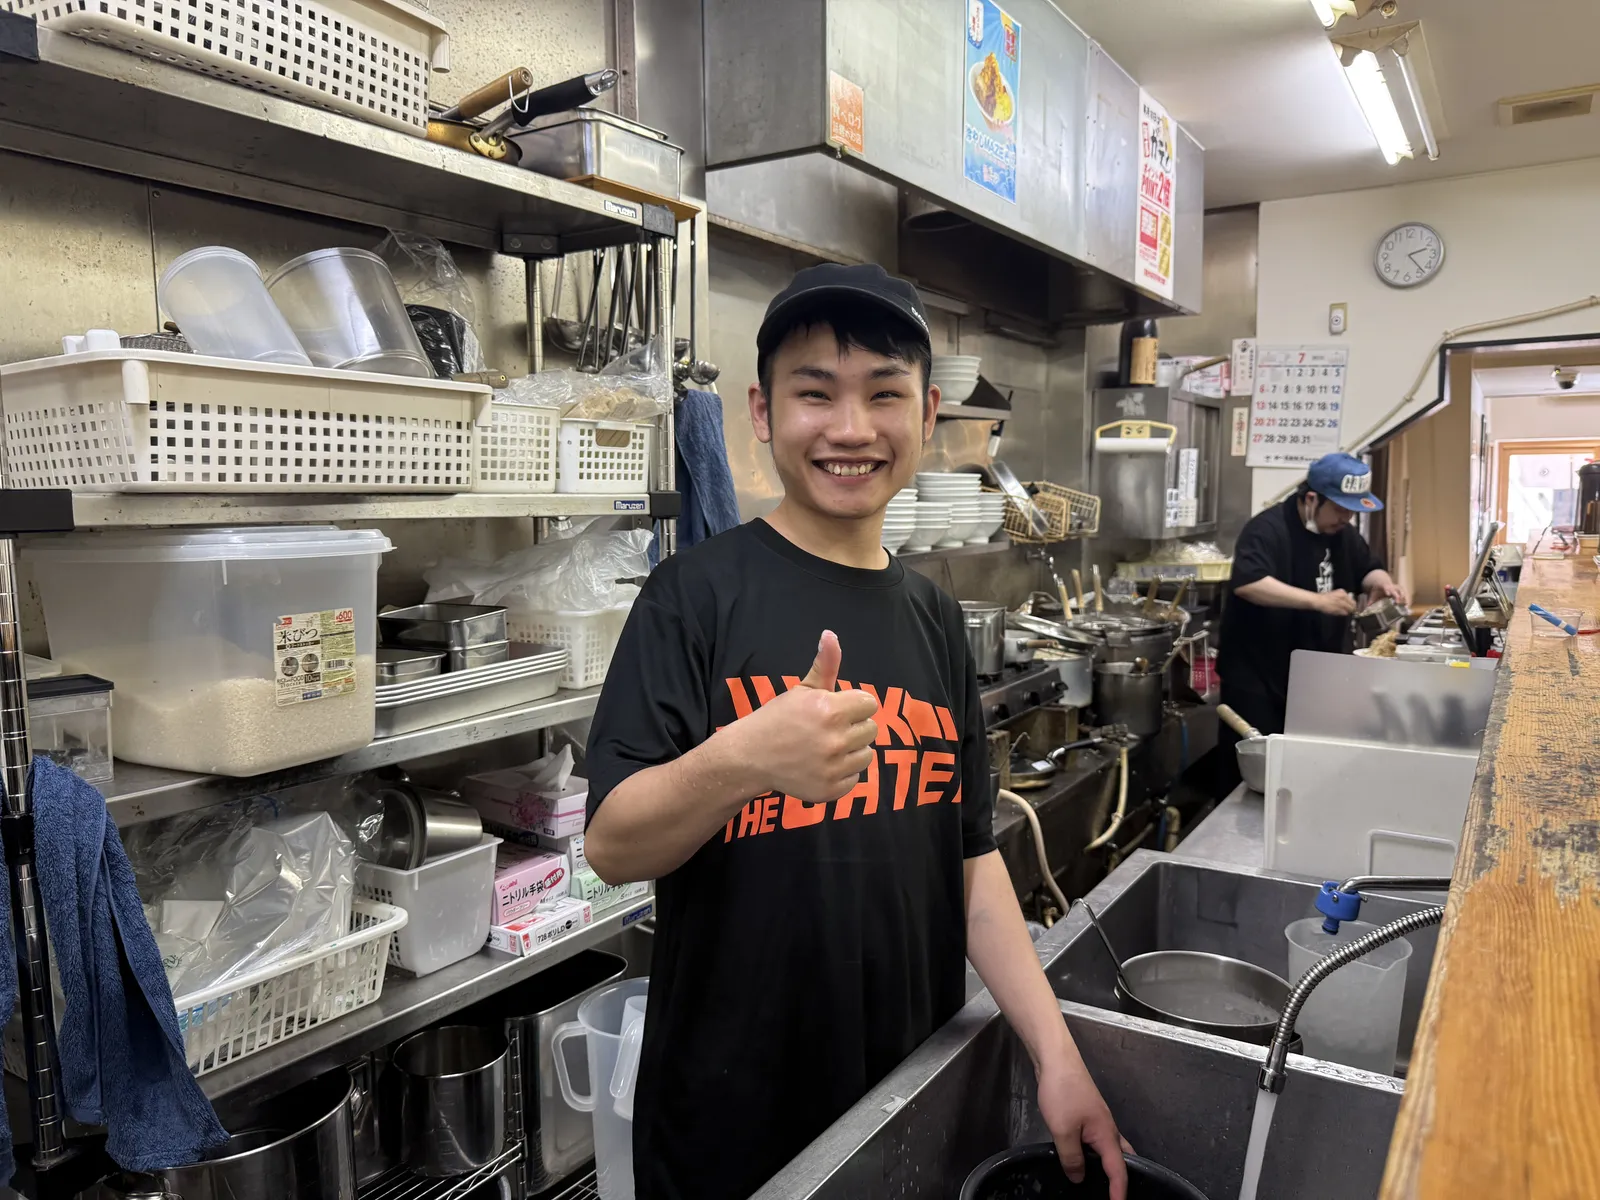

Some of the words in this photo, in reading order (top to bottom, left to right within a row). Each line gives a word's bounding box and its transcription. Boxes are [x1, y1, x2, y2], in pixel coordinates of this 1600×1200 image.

[1395, 232, 1401, 242] 11
[1406, 228, 1415, 239] 12
[1385, 241, 1394, 251] 10
[1425, 236, 1432, 246] 2
[1381, 252, 1388, 262] 9
[1429, 249, 1436, 259] 3
[1384, 263, 1391, 273] 8
[1424, 260, 1431, 269] 4
[1393, 270, 1399, 279] 7
[1403, 272, 1411, 282] 6
[1299, 353, 1305, 363] 7
[1260, 385, 1264, 393] 6
[1272, 385, 1276, 393] 7
[1284, 385, 1288, 393] 8
[1296, 385, 1301, 393] 9
[1307, 385, 1315, 393] 10
[1319, 385, 1327, 393] 11
[1332, 385, 1340, 393] 12
[1256, 402, 1265, 410] 13
[1269, 402, 1277, 410] 14
[1281, 402, 1288, 410] 15
[1293, 402, 1301, 410] 16
[1305, 402, 1314, 410] 17
[1318, 402, 1326, 410] 18
[1330, 402, 1339, 410] 19
[1255, 419, 1263, 427] 20
[1267, 419, 1275, 427] 21
[1279, 419, 1288, 427] 22
[1291, 419, 1300, 427] 23
[1303, 419, 1312, 427] 24
[1315, 419, 1324, 427] 25
[1328, 419, 1337, 427] 26
[1253, 434, 1262, 443] 27
[1265, 434, 1274, 443] 28
[1277, 434, 1286, 443] 29
[1289, 434, 1298, 443] 30
[1301, 434, 1310, 443] 31
[615, 501, 644, 511] Maruzen
[279, 628, 318, 644] 米びつ
[502, 879, 544, 906] ニトリル手袋
